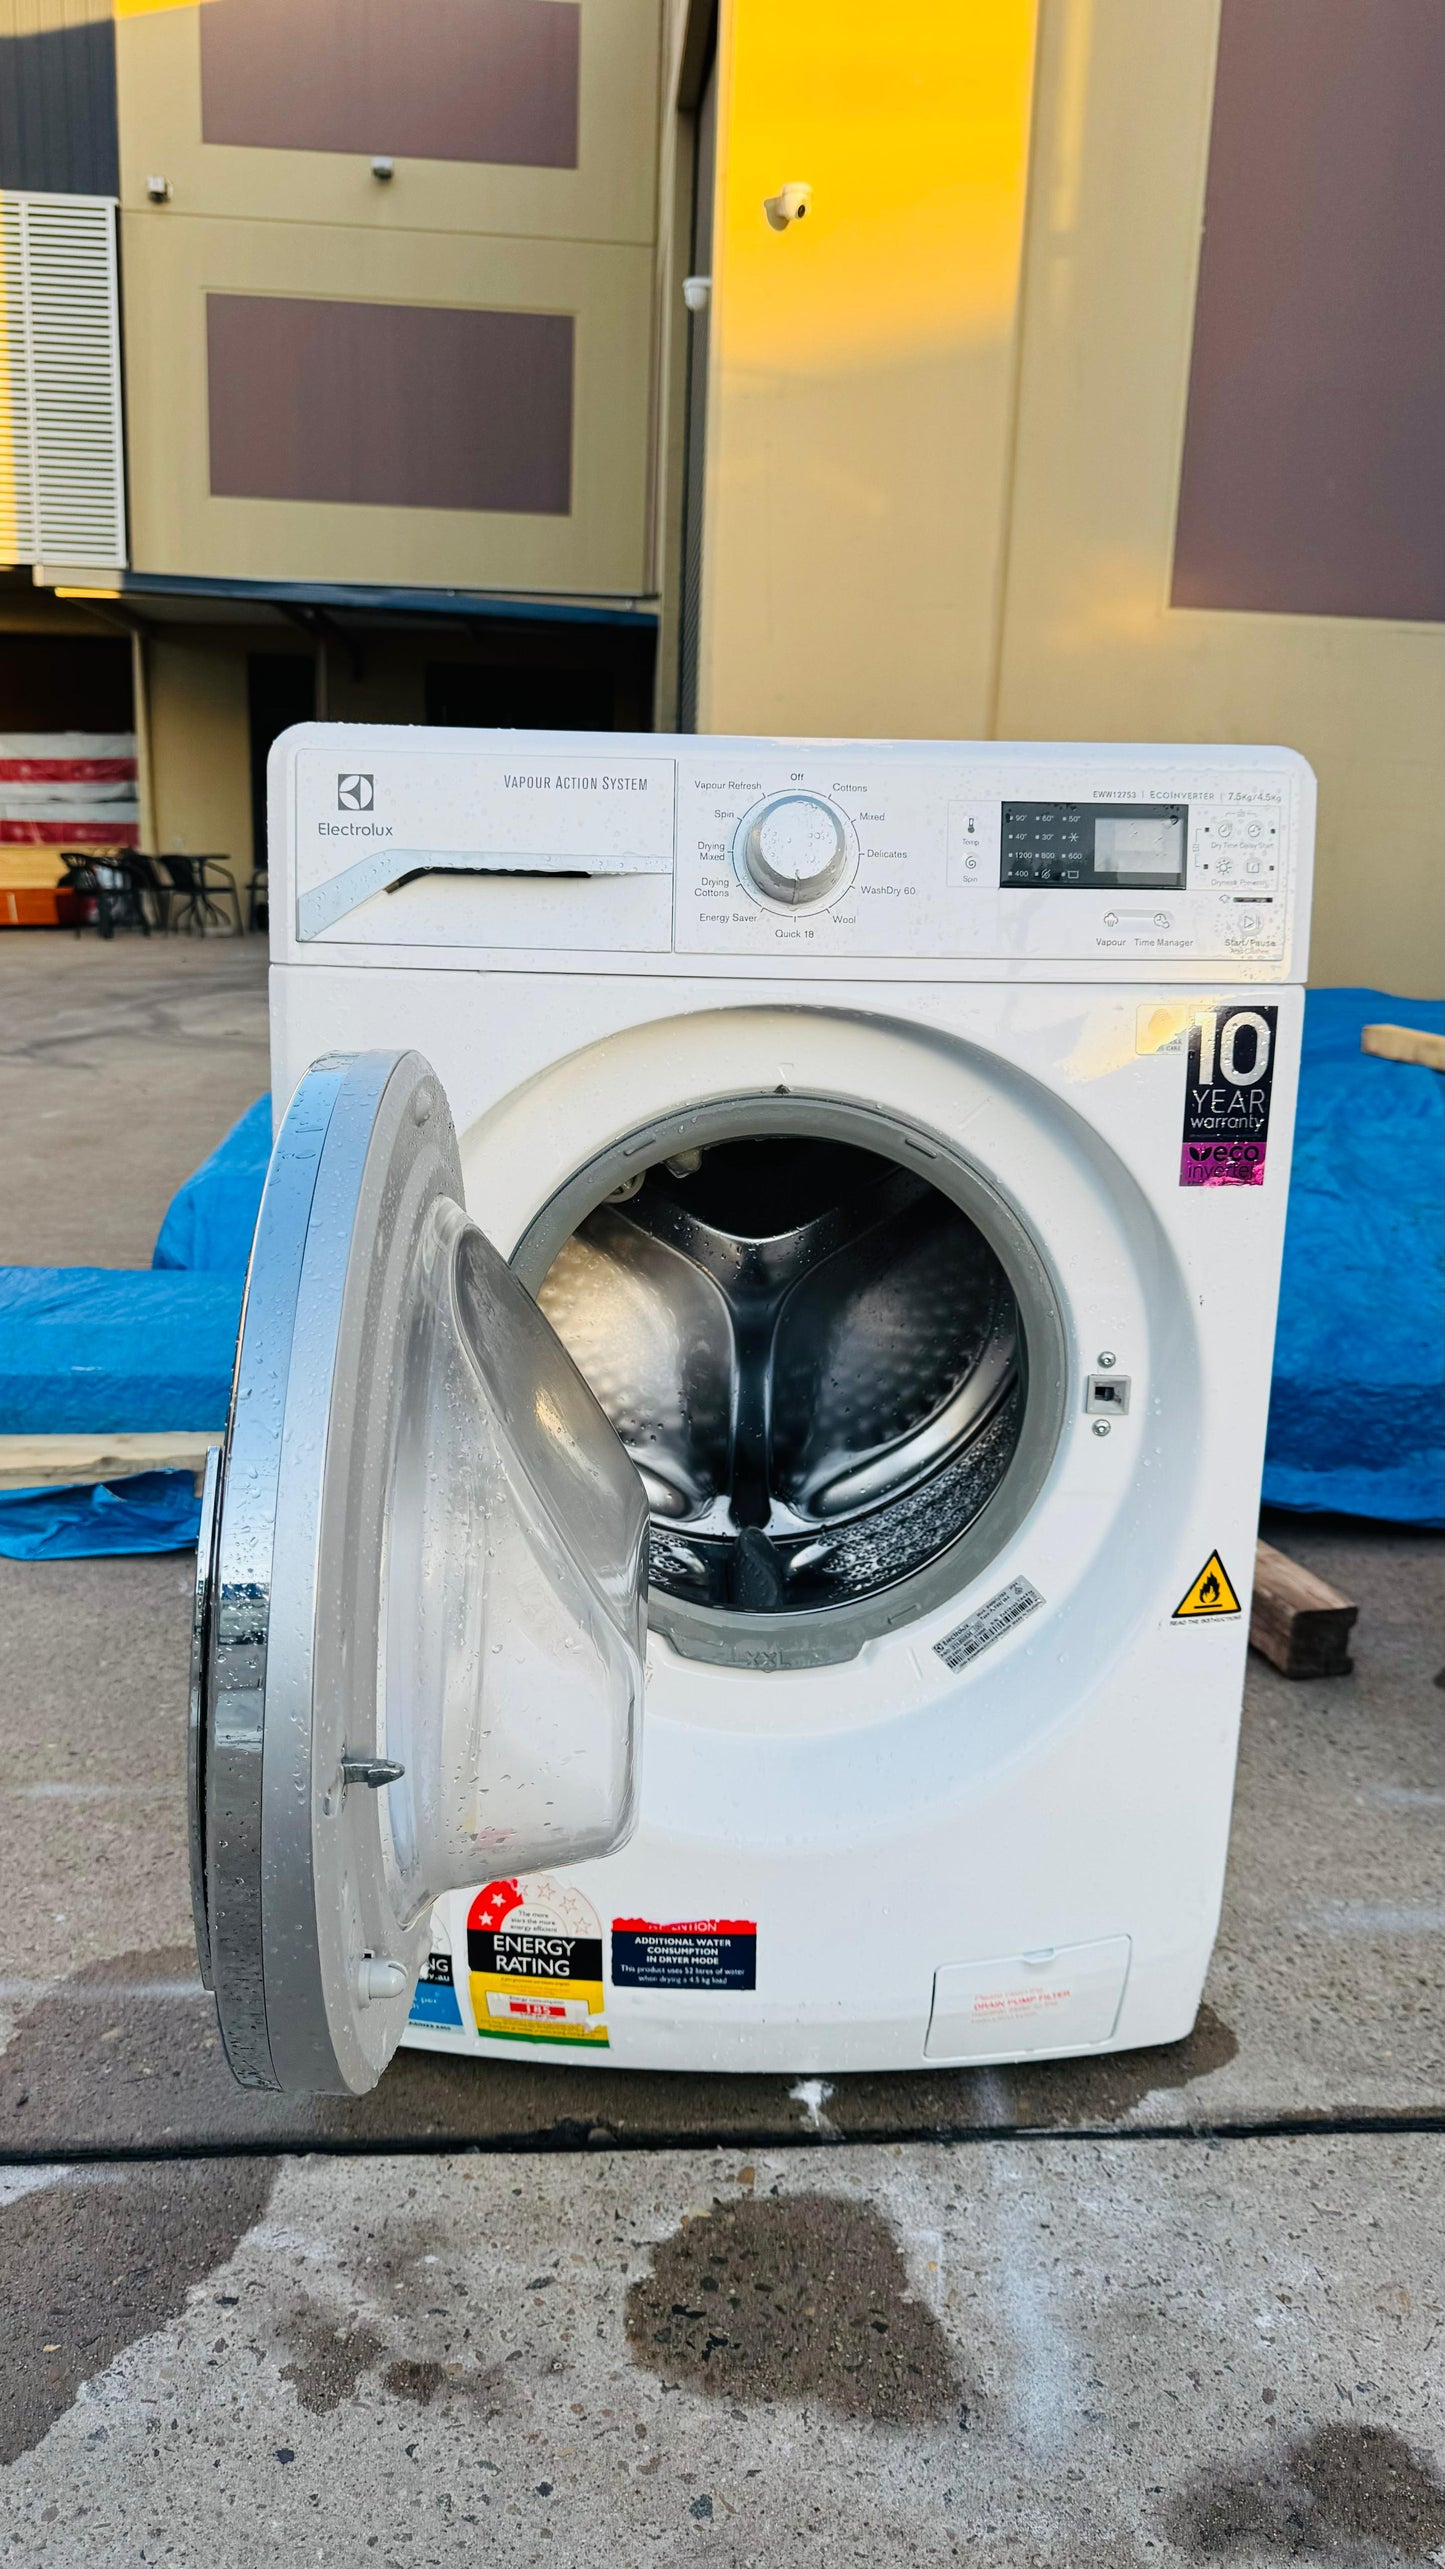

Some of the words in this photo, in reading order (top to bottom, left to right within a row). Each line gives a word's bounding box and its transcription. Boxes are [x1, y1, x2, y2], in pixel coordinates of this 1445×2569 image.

[790, 773, 804, 782] Off
[694, 781, 726, 790] Vapour
[728, 781, 762, 790] Refresh
[832, 783, 868, 793] Cottons
[714, 809, 735, 820] Spin
[859, 812, 885, 822] Mixed
[318, 823, 393, 837] Electrolux
[697, 841, 725, 852] Drying
[699, 852, 725, 861] Mixed
[867, 849, 907, 859] Delicates
[701, 878, 730, 888] Drying
[694, 888, 730, 898] Cottons
[861, 886, 902, 897] WashDry
[904, 886, 916, 895] 60
[699, 914, 730, 924] Energy
[732, 914, 757, 923] Saver
[832, 915, 856, 924] Wool
[775, 930, 801, 940] Quick
[804, 930, 814, 939] 18
[1096, 937, 1126, 948] Vapour
[1134, 937, 1155, 947] Time
[1157, 938, 1193, 948] Manager
[1194, 1011, 1271, 1086] 10
[1192, 1089, 1266, 1114] YEAR
[1190, 1114, 1265, 1132] warranty
[1213, 1145, 1259, 1162] eco
[493, 1934, 576, 1957] ENERGY
[634, 1936, 694, 1947] ADDITIONAL
[696, 1938, 731, 1948] WATER
[647, 1947, 719, 1957] CONSUMPTION
[496, 1954, 570, 1977] RATING
[646, 1956, 656, 1964] IN
[659, 1956, 689, 1965] DRYER
[691, 1957, 719, 1966] MODE
[620, 1964, 636, 1973] This
[637, 1966, 665, 1975] product
[715, 1968, 723, 1976] of
[659, 1976, 681, 1985] drying
